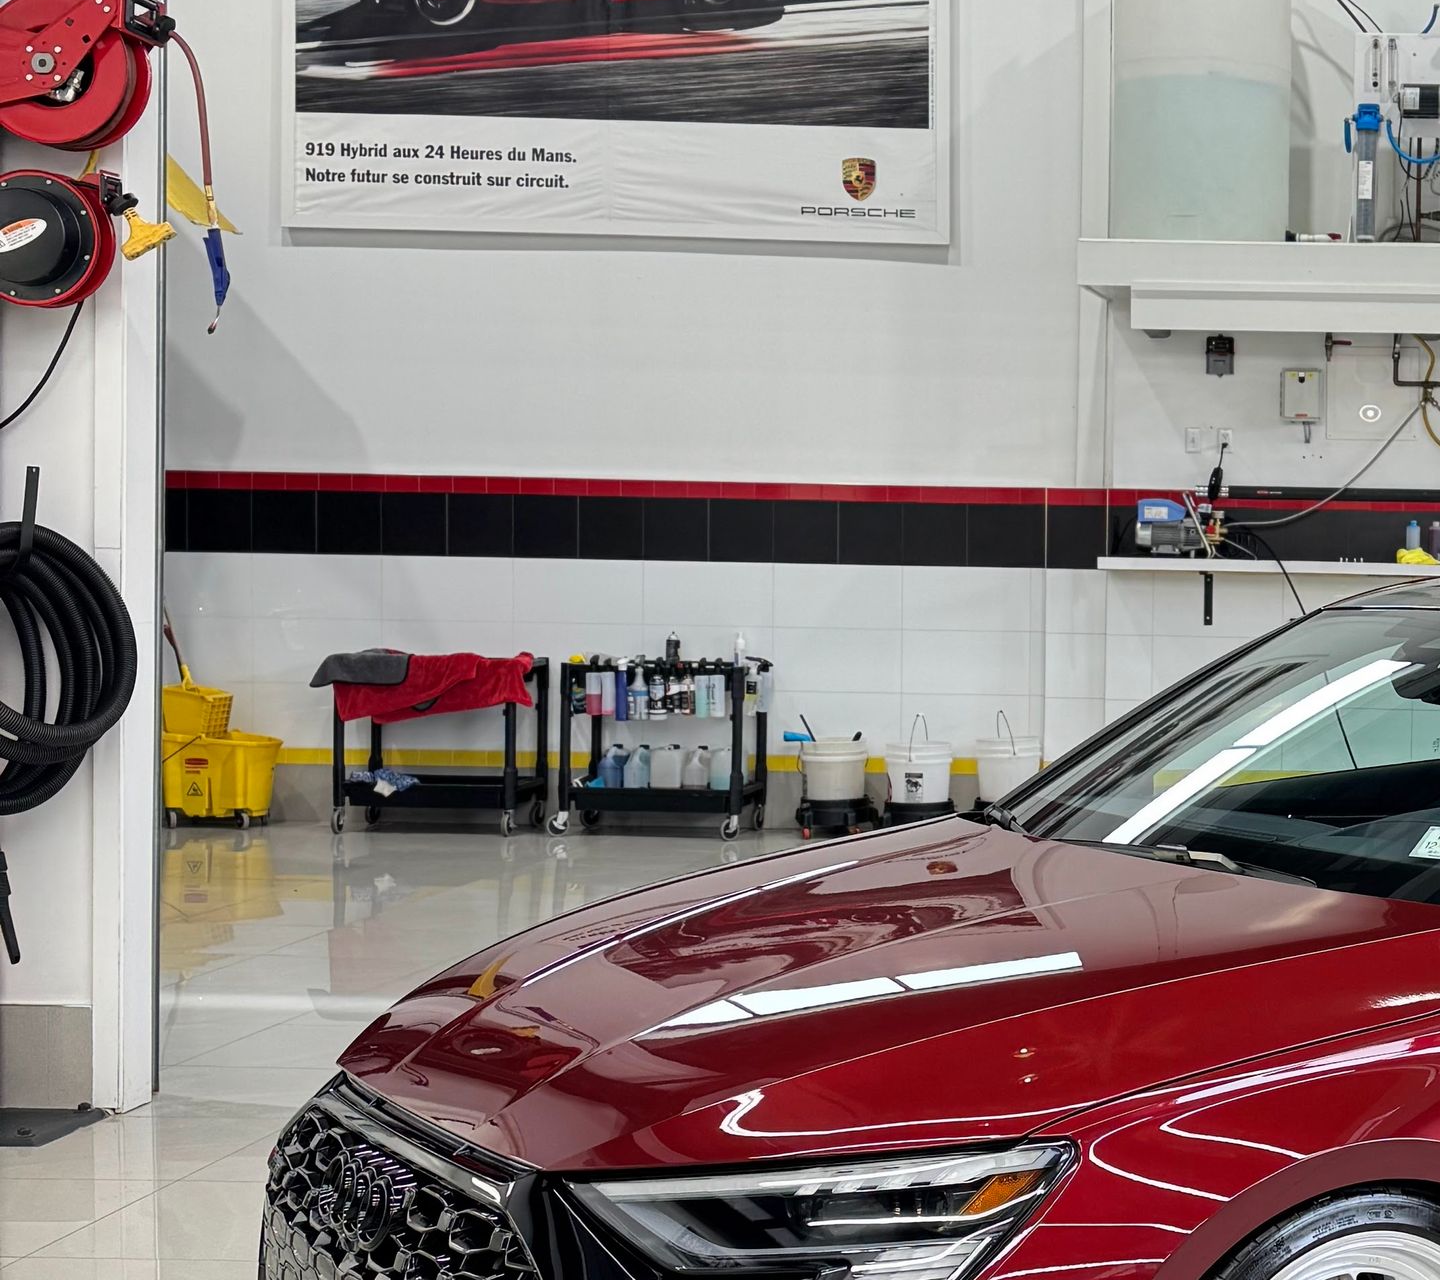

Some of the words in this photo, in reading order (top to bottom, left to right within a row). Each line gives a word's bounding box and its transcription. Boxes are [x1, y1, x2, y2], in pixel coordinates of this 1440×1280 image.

[305, 142, 335, 157] 919
[340, 143, 387, 160] Hybrid
[392, 146, 420, 159] aux
[424, 144, 445, 159] 24
[450, 145, 503, 161] Heures
[507, 147, 526, 162] du
[531, 148, 577, 163] Mans.
[305, 168, 346, 183] Notre
[350, 169, 388, 184] futur
[392, 173, 410, 185] se
[414, 171, 482, 187] construit
[487, 175, 512, 188] sur
[516, 173, 570, 189] circuit.
[801, 206, 916, 219] PORSCHE
[1424, 841, 1438, 850] 12
